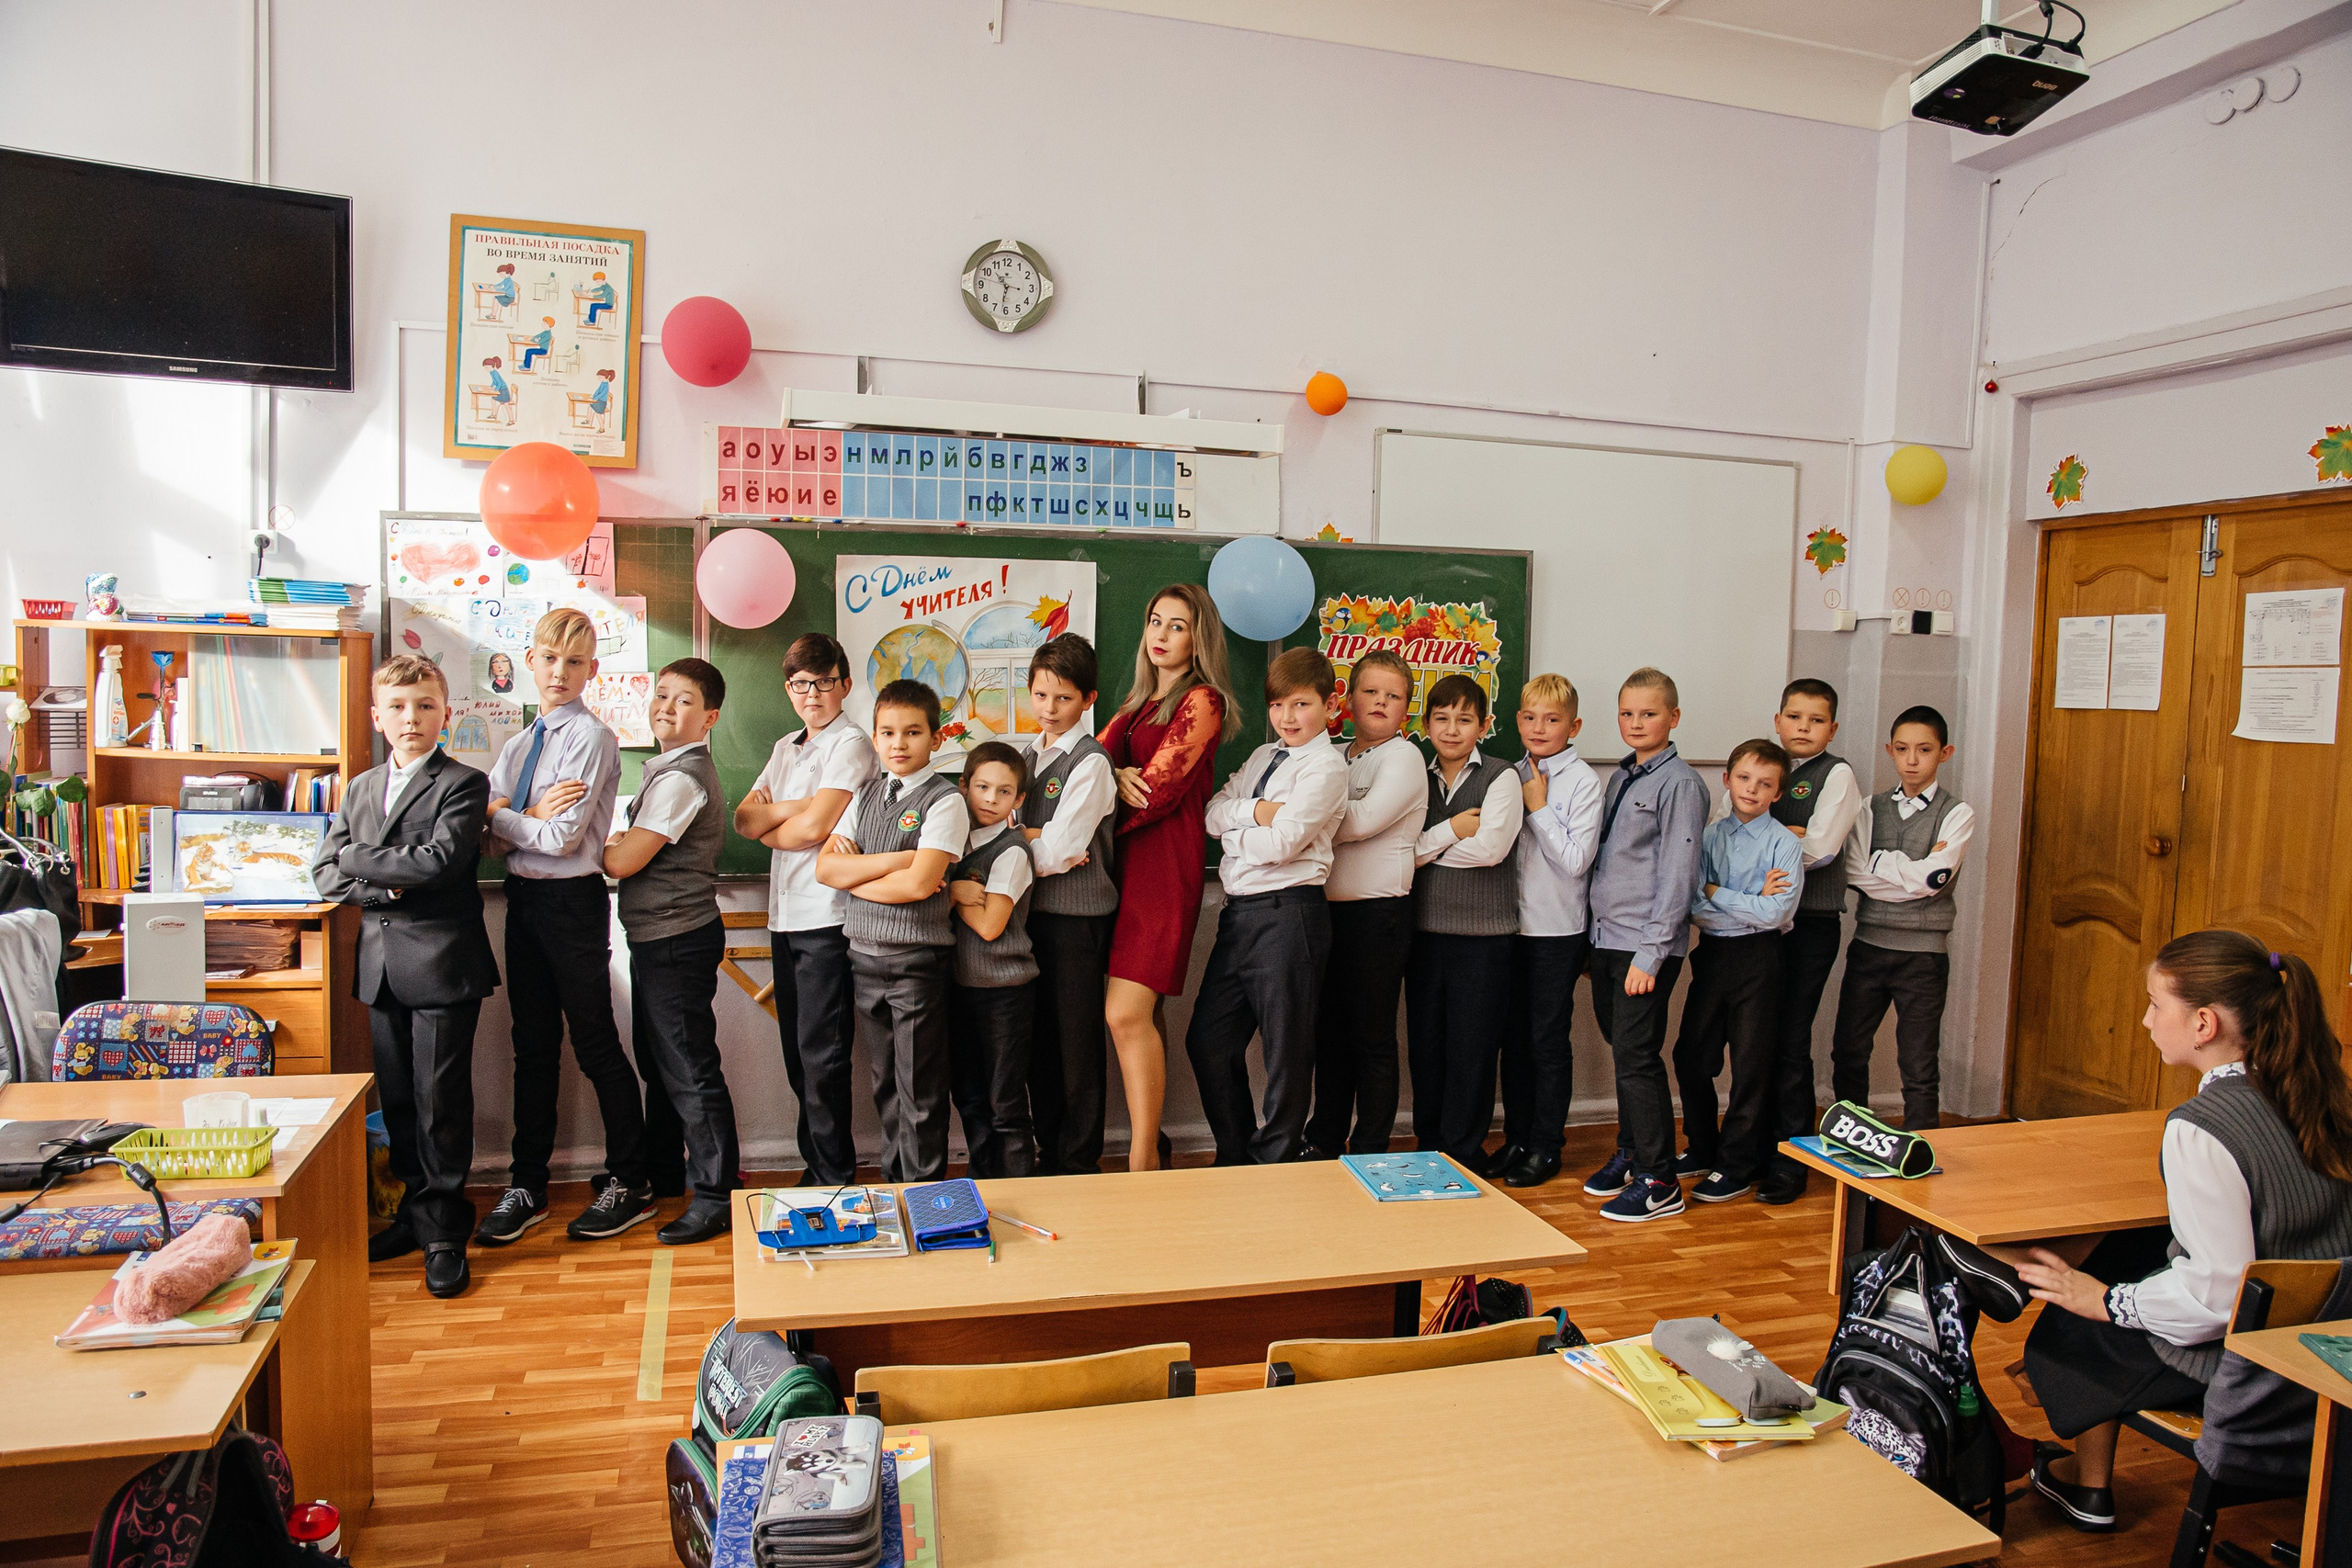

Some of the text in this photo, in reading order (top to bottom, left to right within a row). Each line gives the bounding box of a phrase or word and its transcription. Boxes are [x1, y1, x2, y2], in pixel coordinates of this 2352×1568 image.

[475, 233, 621, 256] ПРАВИЛЬНАЯ ПОСАДКА
[486, 247, 608, 267] ВО ВРЕМЯ ЗАНЯТИЙ
[992, 261, 1000, 270] 11
[1002, 258, 1012, 266] 12
[1017, 263, 1022, 271] 1
[982, 268, 992, 276] 10
[1024, 271, 1031, 279] 2
[978, 280, 984, 288] 9
[983, 294, 989, 302] 8
[1023, 297, 1029, 305] 4
[1015, 304, 1021, 312] 5
[845, 564, 954, 614] С Днём
[1328, 634, 1481, 669] ПРАЗДНИК
[1829, 1114, 1899, 1157] BOSS
